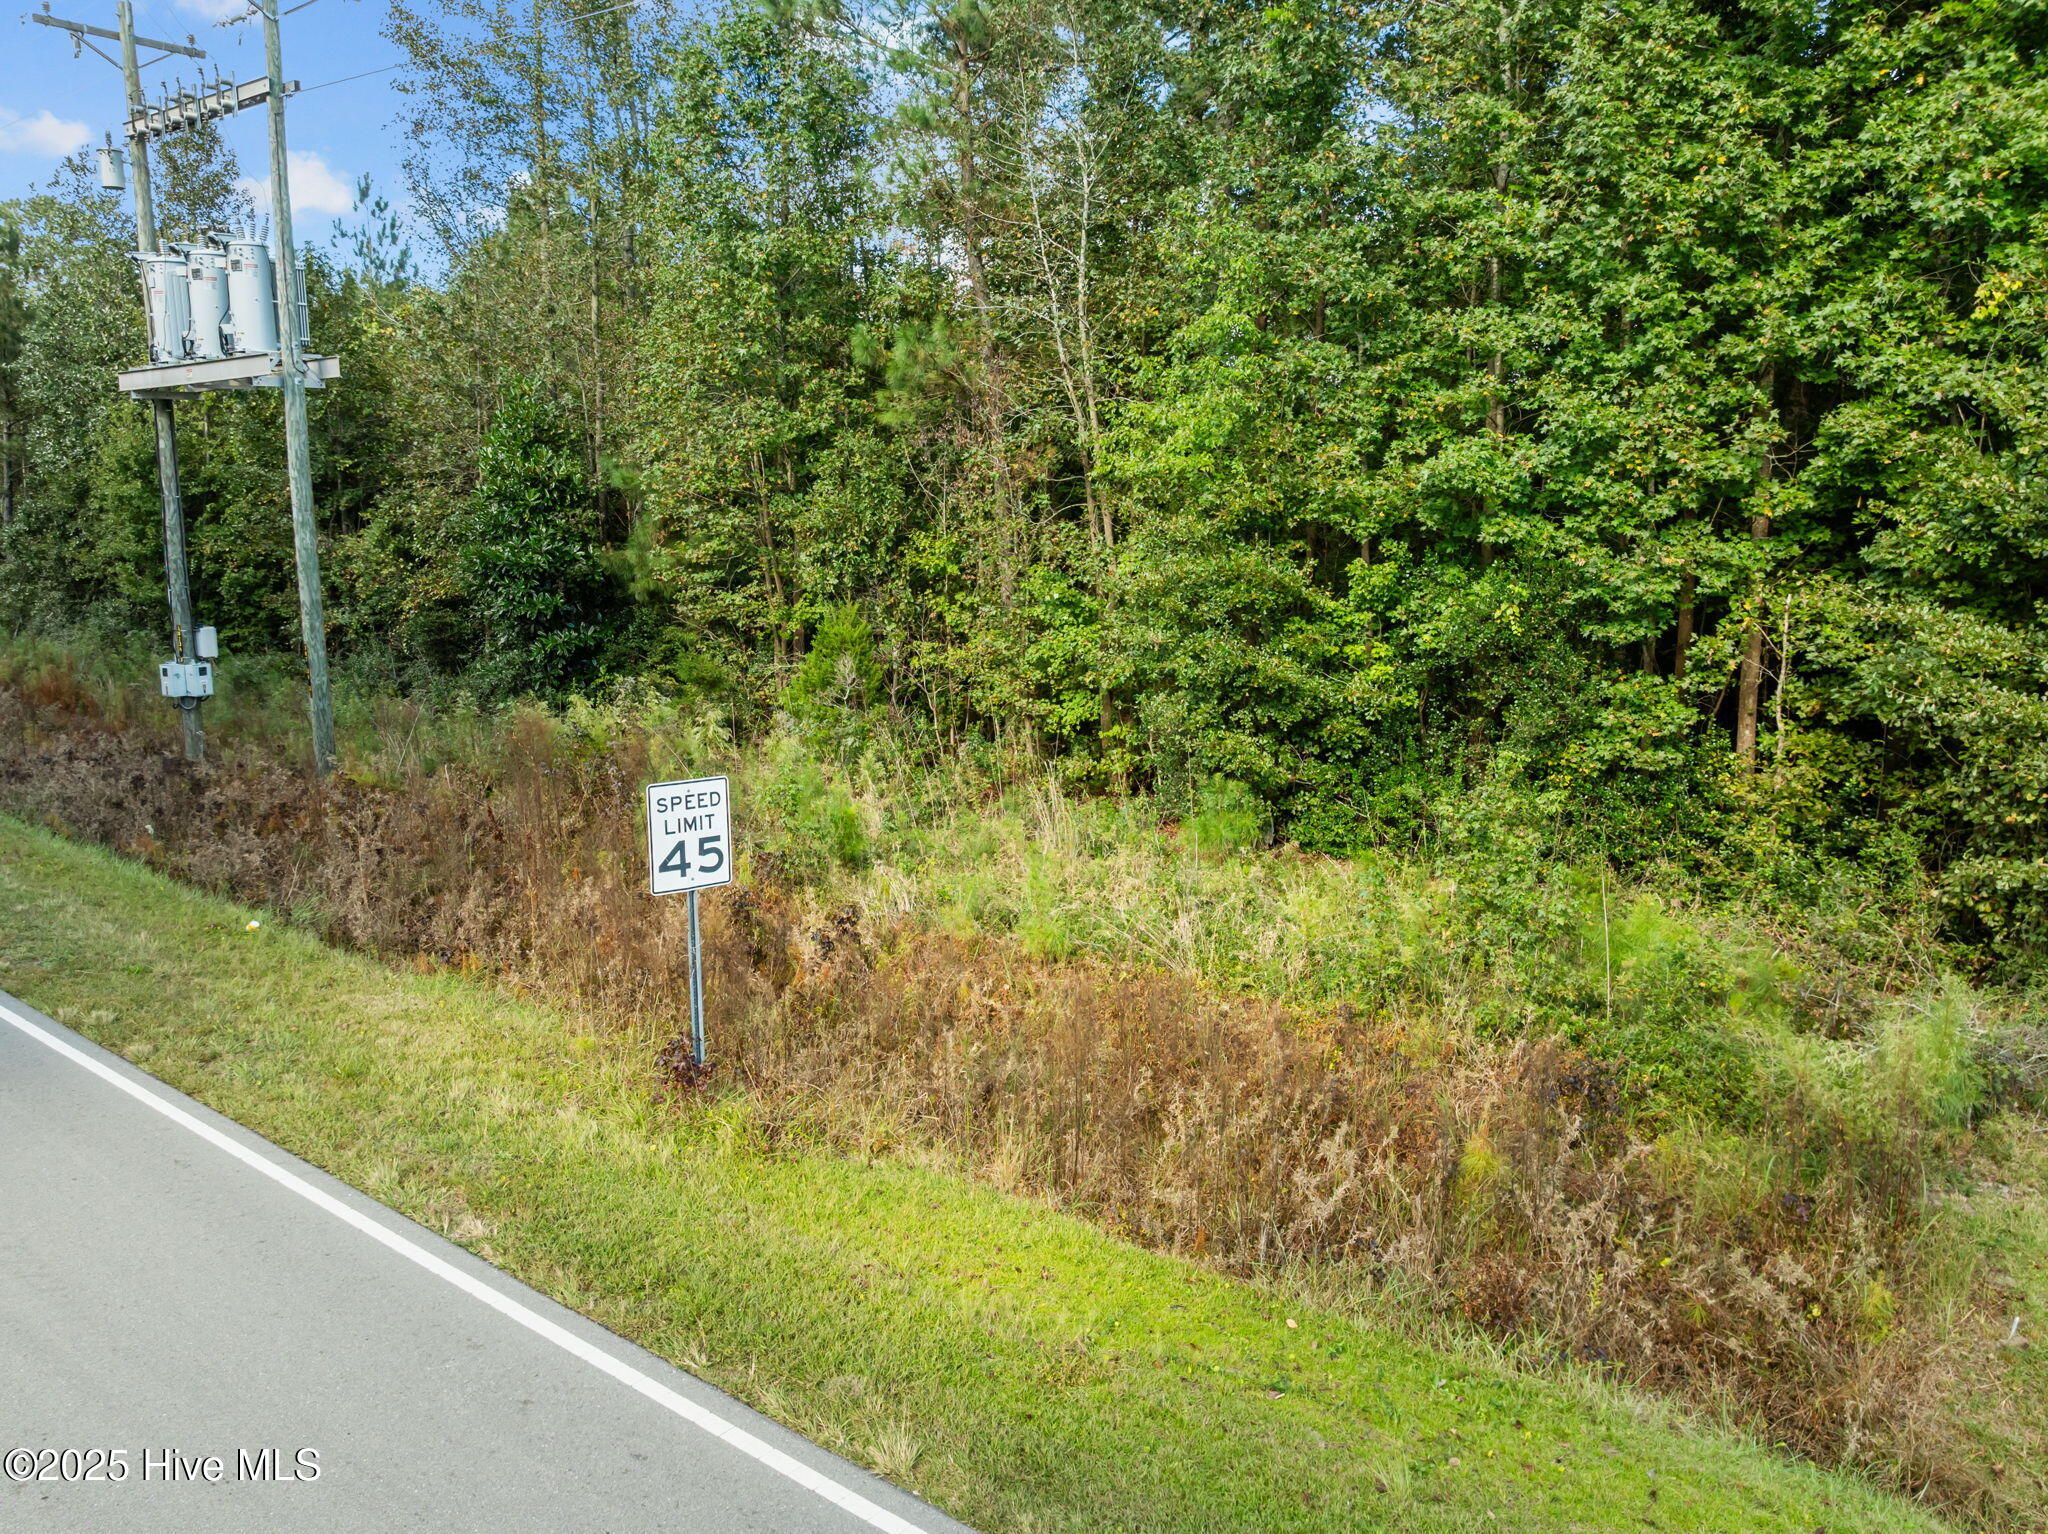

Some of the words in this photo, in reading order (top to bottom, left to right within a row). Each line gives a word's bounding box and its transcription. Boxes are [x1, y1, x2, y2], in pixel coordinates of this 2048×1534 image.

[657, 791, 721, 813] SPEED
[665, 814, 715, 835] LIMIT
[658, 835, 724, 877] 45
